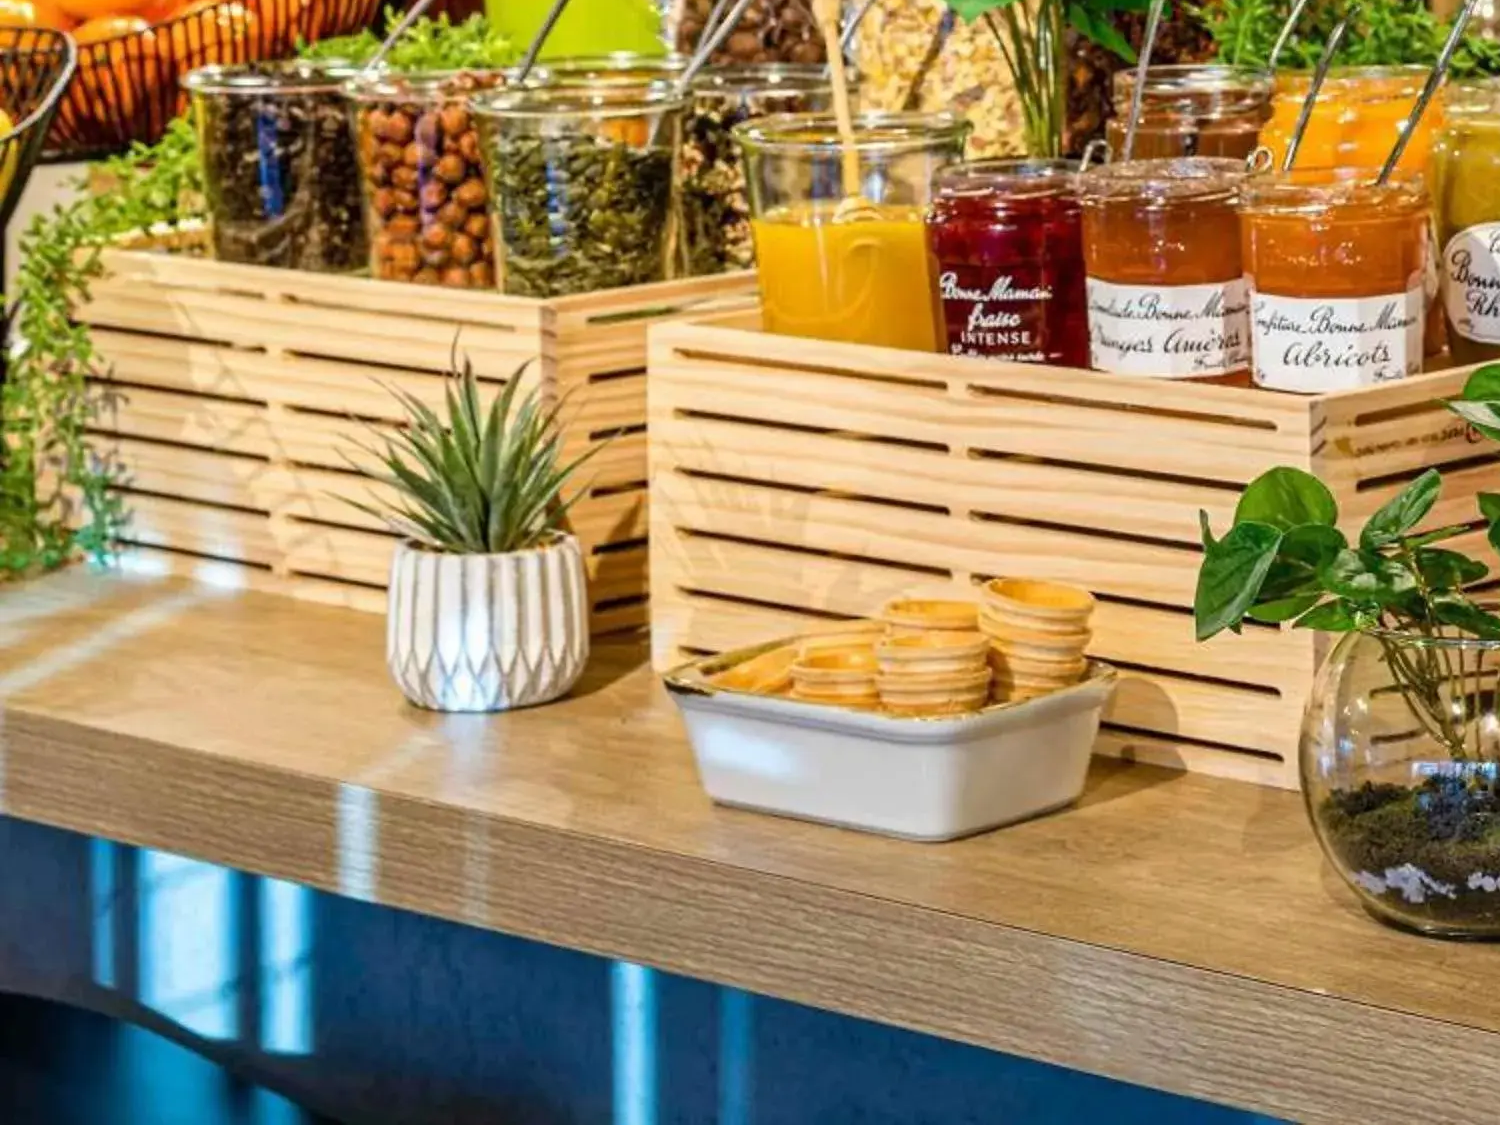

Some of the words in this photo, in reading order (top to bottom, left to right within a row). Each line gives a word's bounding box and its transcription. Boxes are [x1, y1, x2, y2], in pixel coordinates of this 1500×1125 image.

[1308, 305, 1369, 334] Bonne
[960, 330, 1031, 346] INTENSE
[1282, 340, 1392, 368] Abricots
